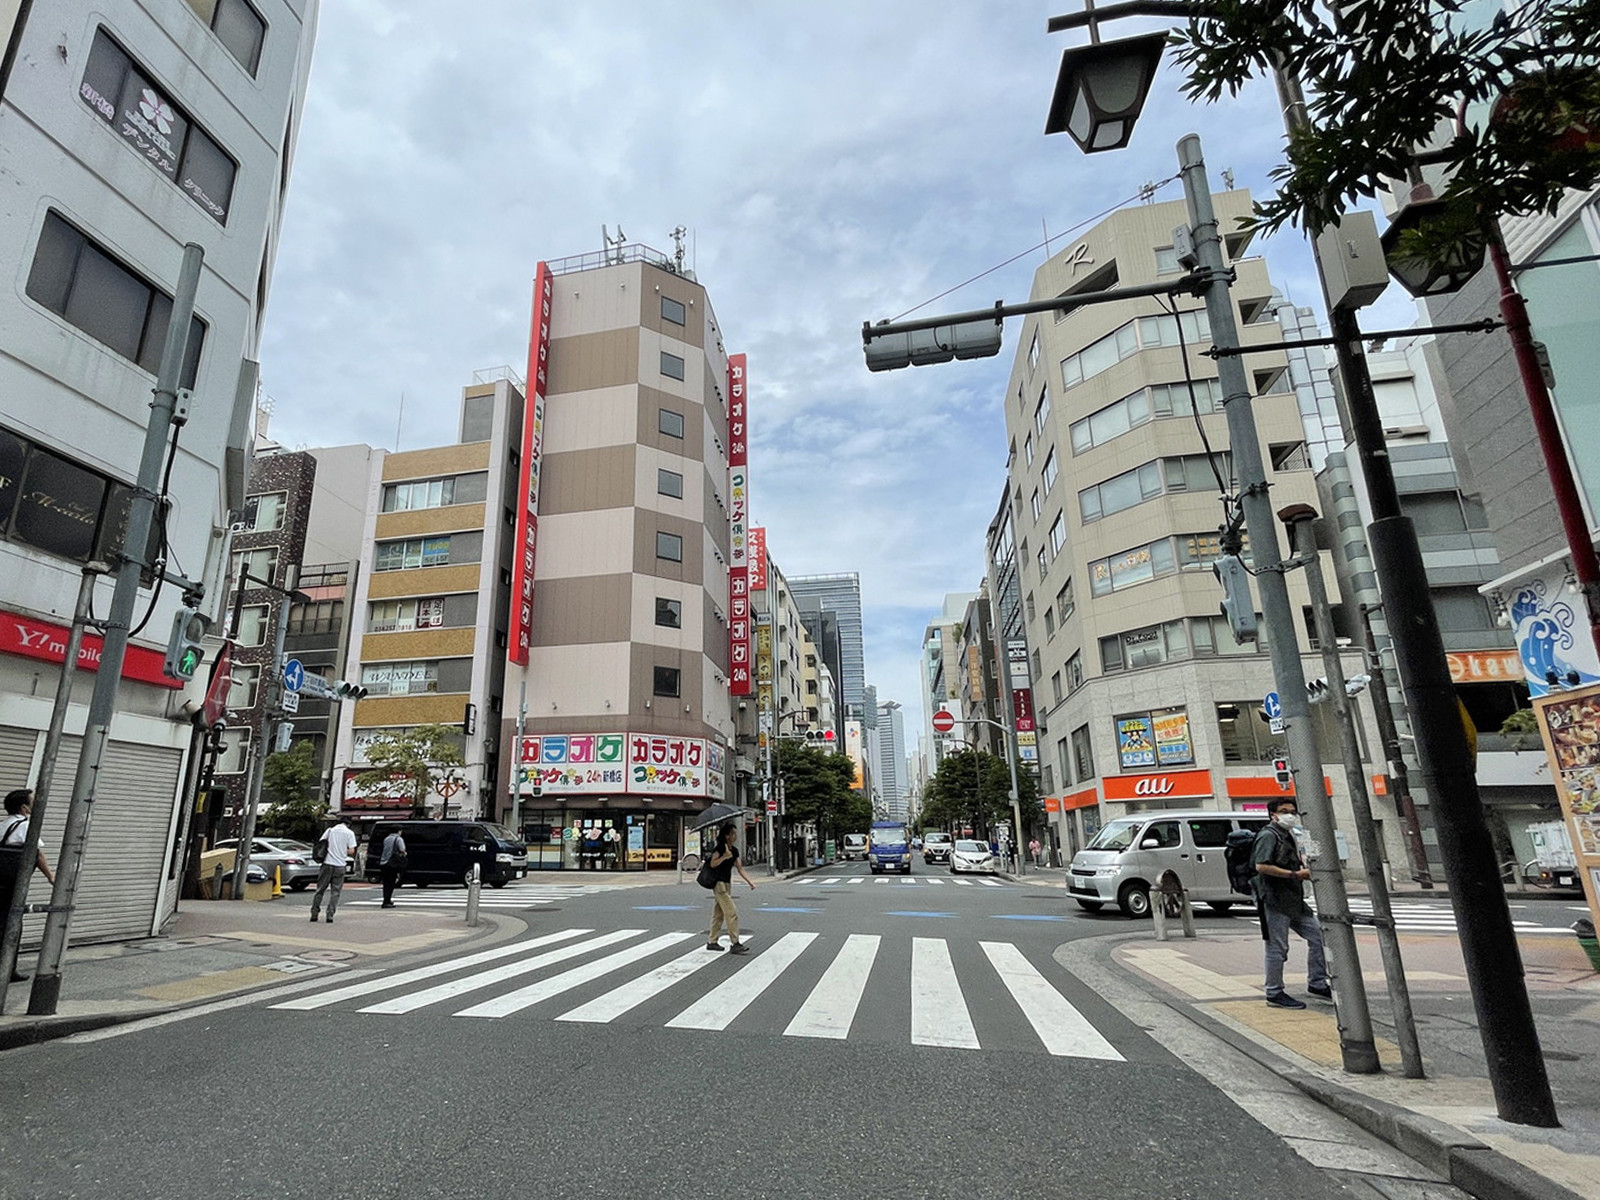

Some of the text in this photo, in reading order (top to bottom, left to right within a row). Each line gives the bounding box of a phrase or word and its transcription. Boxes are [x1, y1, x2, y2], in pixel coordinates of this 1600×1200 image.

[539, 280, 552, 361] カラオケ
[731, 366, 746, 454] カラオケ 24h
[521, 527, 535, 624] カラオケ
[732, 578, 748, 682] カラオケ 24h
[522, 736, 622, 762] カラオケ
[632, 738, 702, 766] カラオケ
[1135, 777, 1174, 796] au
